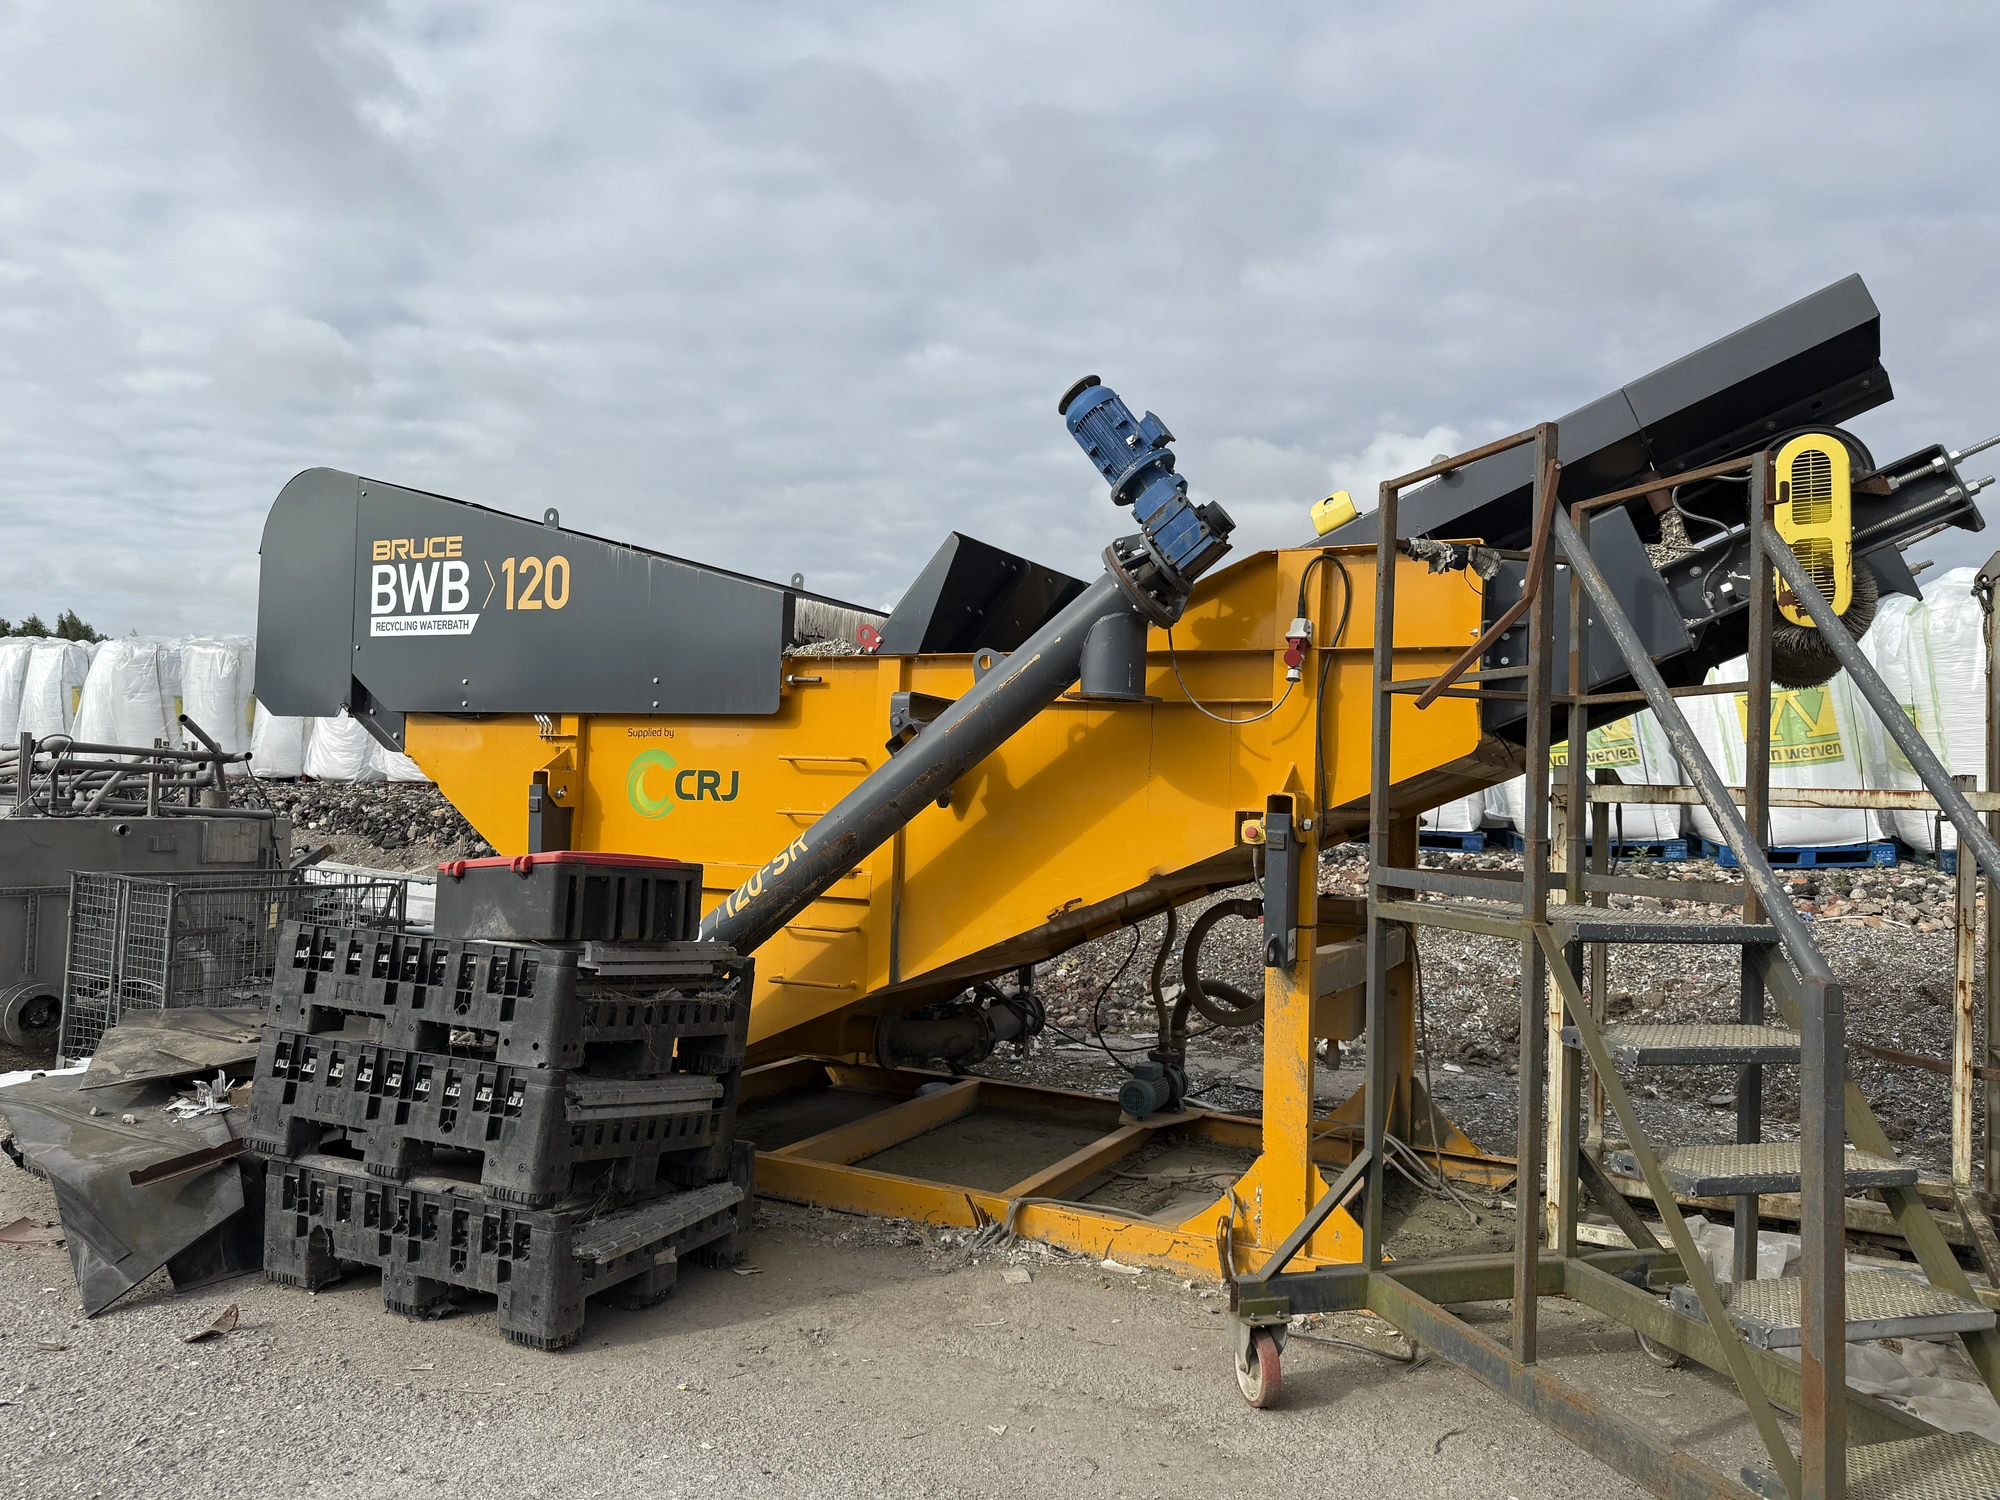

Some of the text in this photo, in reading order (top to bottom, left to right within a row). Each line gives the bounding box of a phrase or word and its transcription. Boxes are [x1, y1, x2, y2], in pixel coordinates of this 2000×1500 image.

[373, 535, 463, 561] BRUCE
[371, 555, 571, 614] BWB 120
[375, 619, 470, 632] RECYCLING WATERBATH
[627, 727, 675, 739] Supplied by
[1784, 742, 1842, 760] werven
[674, 769, 740, 801] CRJ
